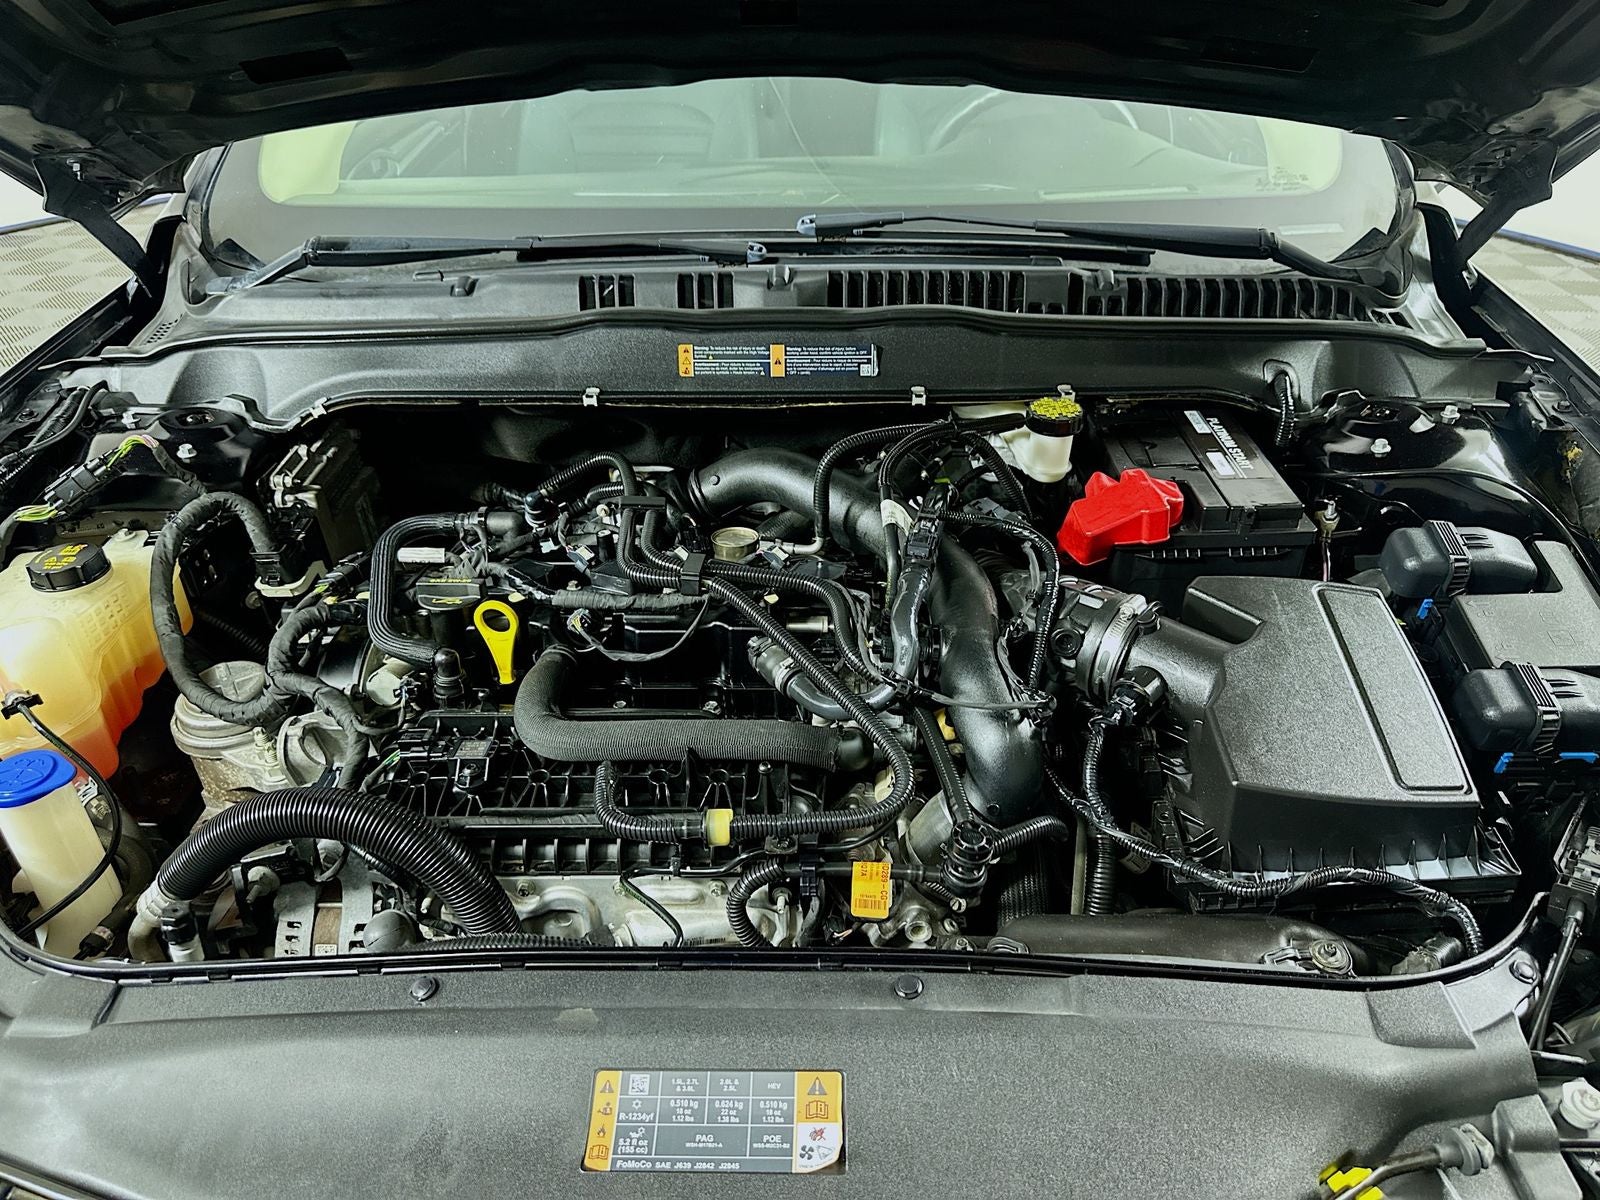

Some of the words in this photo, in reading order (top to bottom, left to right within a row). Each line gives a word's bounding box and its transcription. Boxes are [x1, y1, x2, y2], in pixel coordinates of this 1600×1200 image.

[1206, 417, 1238, 448] PLATINUM
[1228, 448, 1254, 470] START
[690, 1100, 698, 1109] kg
[734, 1101, 743, 1110] kg
[778, 1101, 788, 1110] kg
[619, 1112, 654, 1122] R-1234yf
[616, 1160, 652, 1169] FoMoCo
